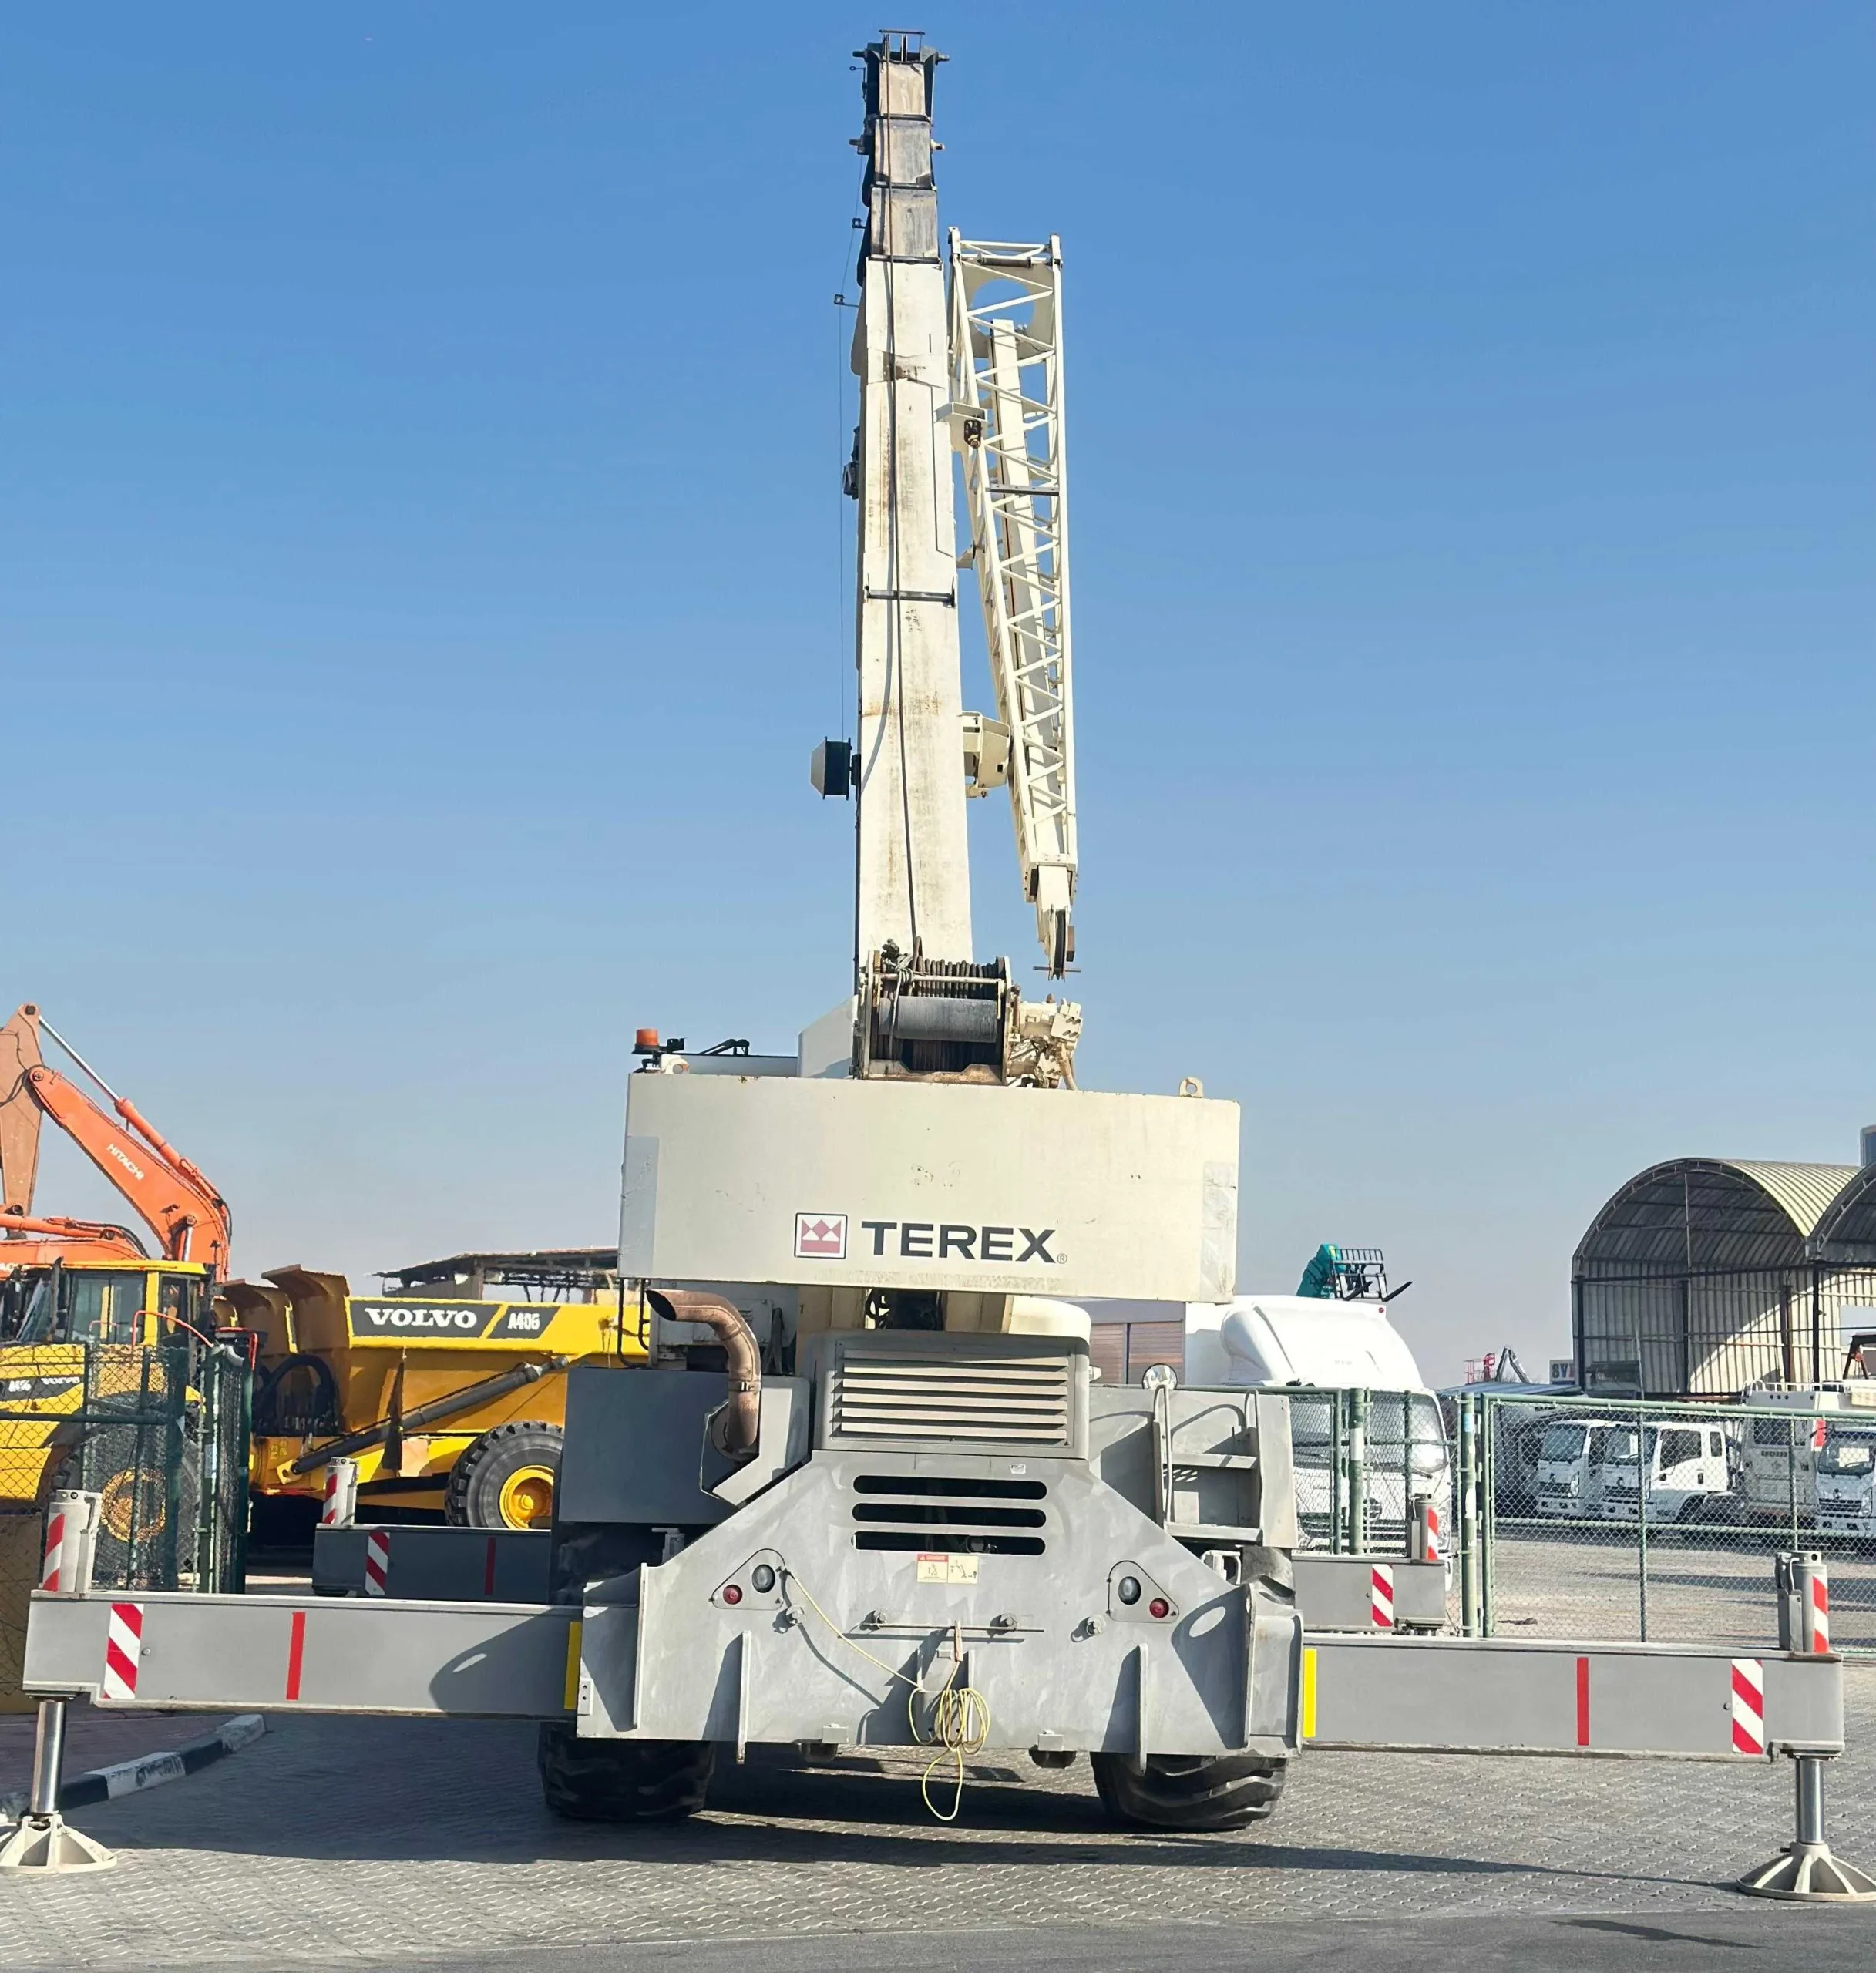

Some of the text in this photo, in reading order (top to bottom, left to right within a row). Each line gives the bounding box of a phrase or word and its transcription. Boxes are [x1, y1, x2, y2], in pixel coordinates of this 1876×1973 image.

[106, 1143, 145, 1180] HITACHI
[861, 1221, 1056, 1263] TEREX
[365, 1307, 477, 1329] VOLVO
